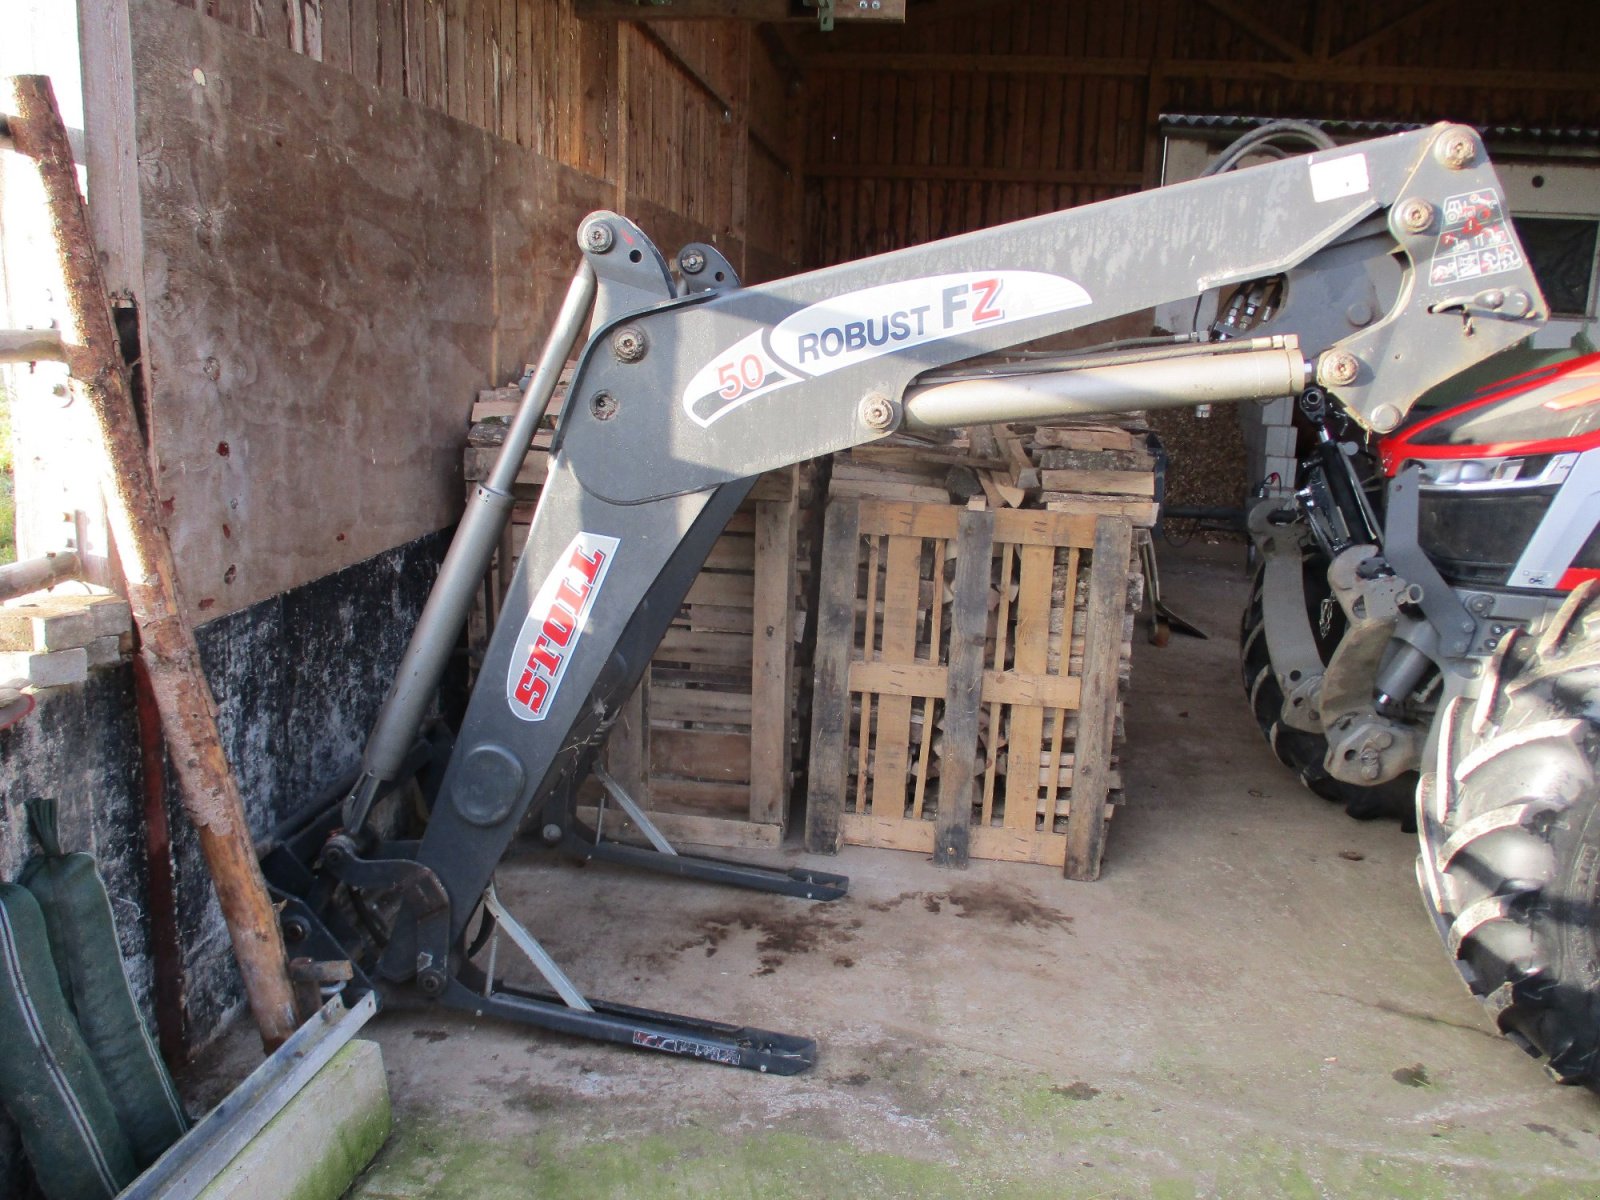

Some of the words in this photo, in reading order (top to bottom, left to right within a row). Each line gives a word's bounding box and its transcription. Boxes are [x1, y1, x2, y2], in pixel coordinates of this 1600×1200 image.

[798, 305, 930, 363] ROBUST
[941, 279, 1004, 328] FZ
[718, 358, 765, 398] 50
[514, 546, 606, 714] STOLL
